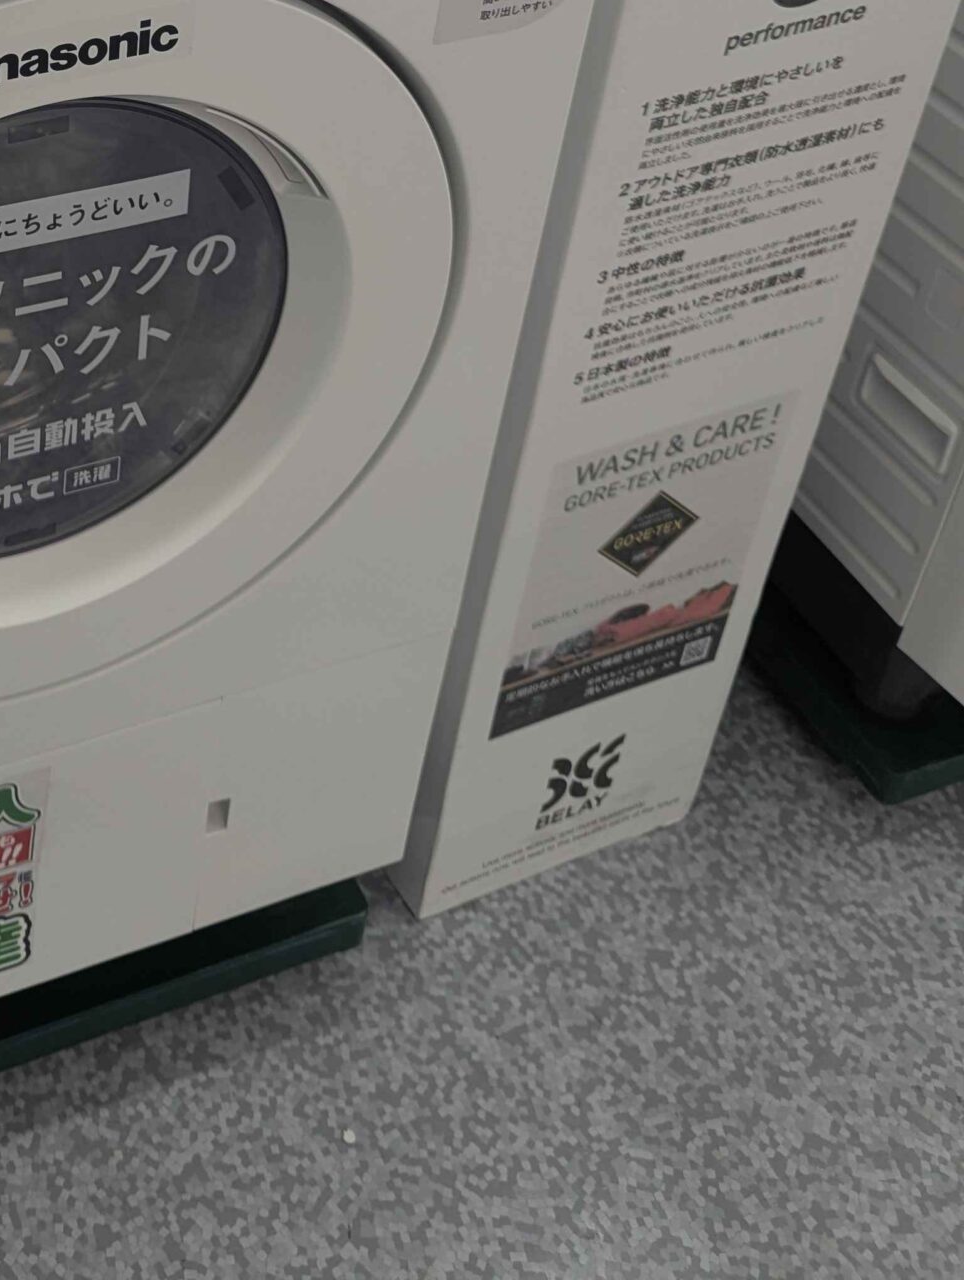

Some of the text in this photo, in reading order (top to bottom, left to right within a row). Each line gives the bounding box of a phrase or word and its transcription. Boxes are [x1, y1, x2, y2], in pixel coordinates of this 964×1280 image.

[723, 2, 868, 56] performance
[648, 91, 770, 133] 両立した独自配合
[628, 175, 732, 212] 適した洗浄能力
[611, 249, 686, 280] 中性の特徴
[586, 345, 672, 383] 日本製の特徴
[7, 401, 148, 461] 自動投入
[73, 464, 112, 487] 洗濯
[562, 431, 776, 513] GORE-TEX PRODUCTS
[573, 442, 660, 487] WASH
[668, 432, 685, 456] &
[612, 517, 684, 552] GORE-TEX
[535, 791, 609, 831] BELAY
